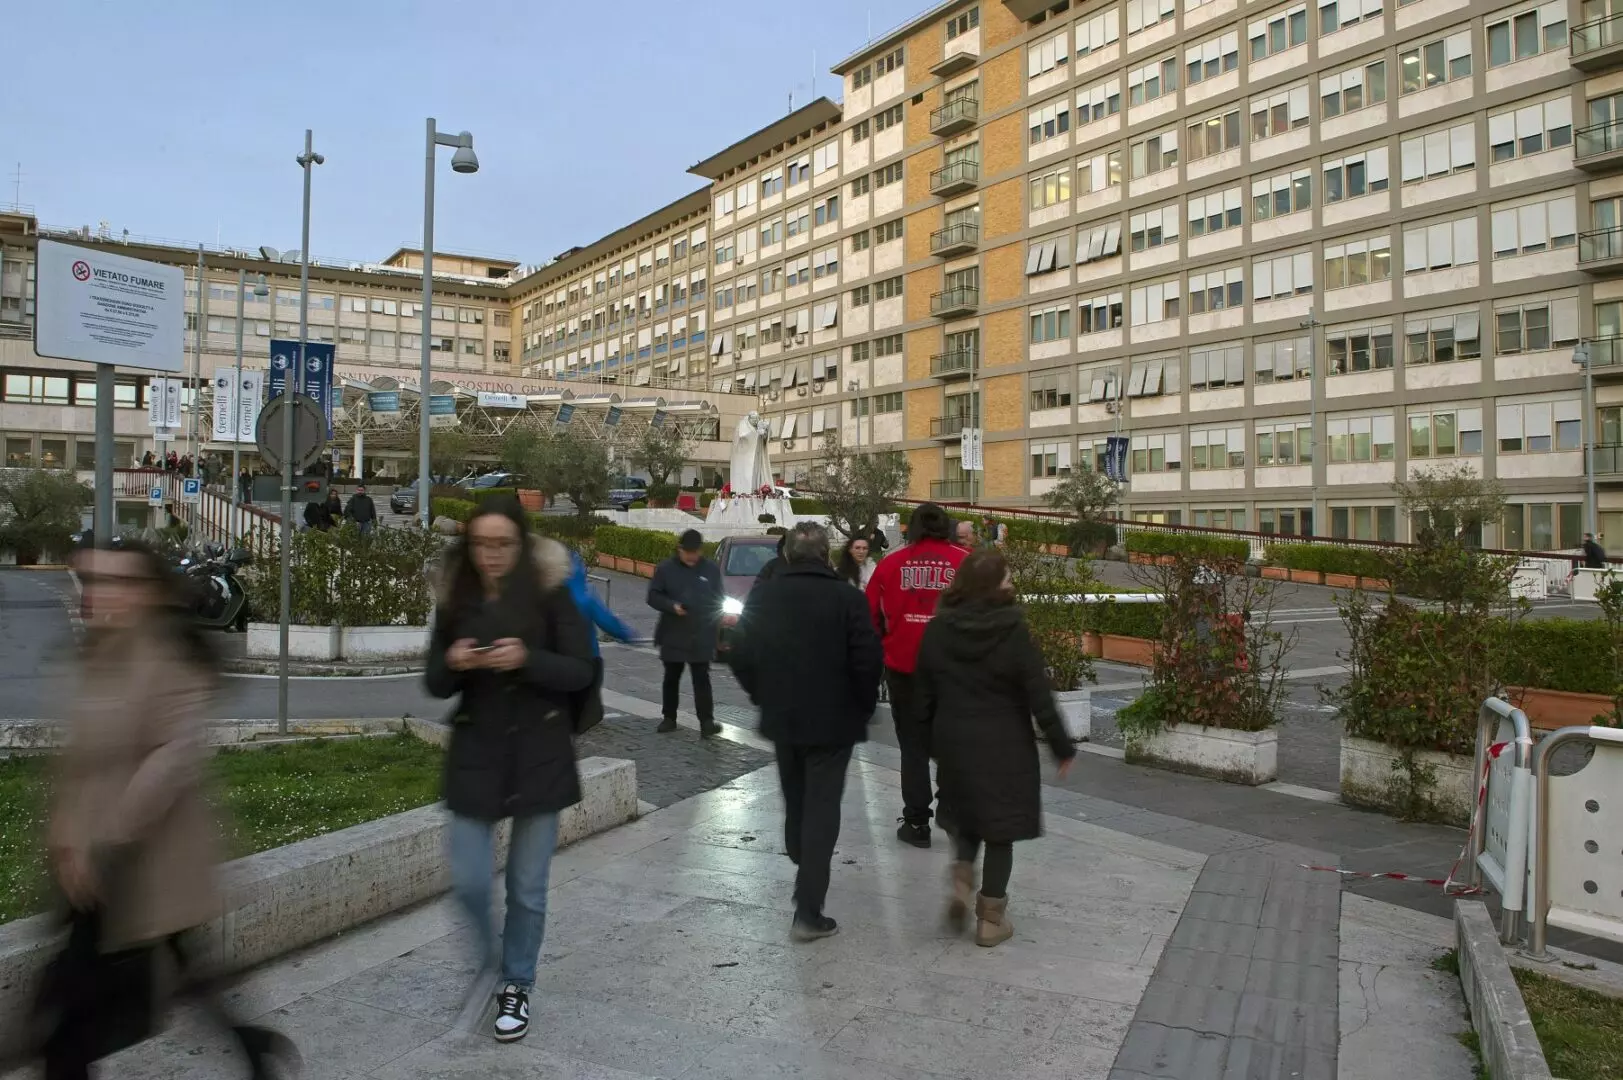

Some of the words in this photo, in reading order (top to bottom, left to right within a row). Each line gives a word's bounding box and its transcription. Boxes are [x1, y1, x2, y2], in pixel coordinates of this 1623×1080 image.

[93, 268, 128, 282] VIETATO
[130, 276, 165, 290] FUMARE
[217, 395, 228, 434] Gemelli
[241, 397, 252, 436] Gemelli
[188, 481, 196, 491] P
[900, 566, 956, 589] BULLS
